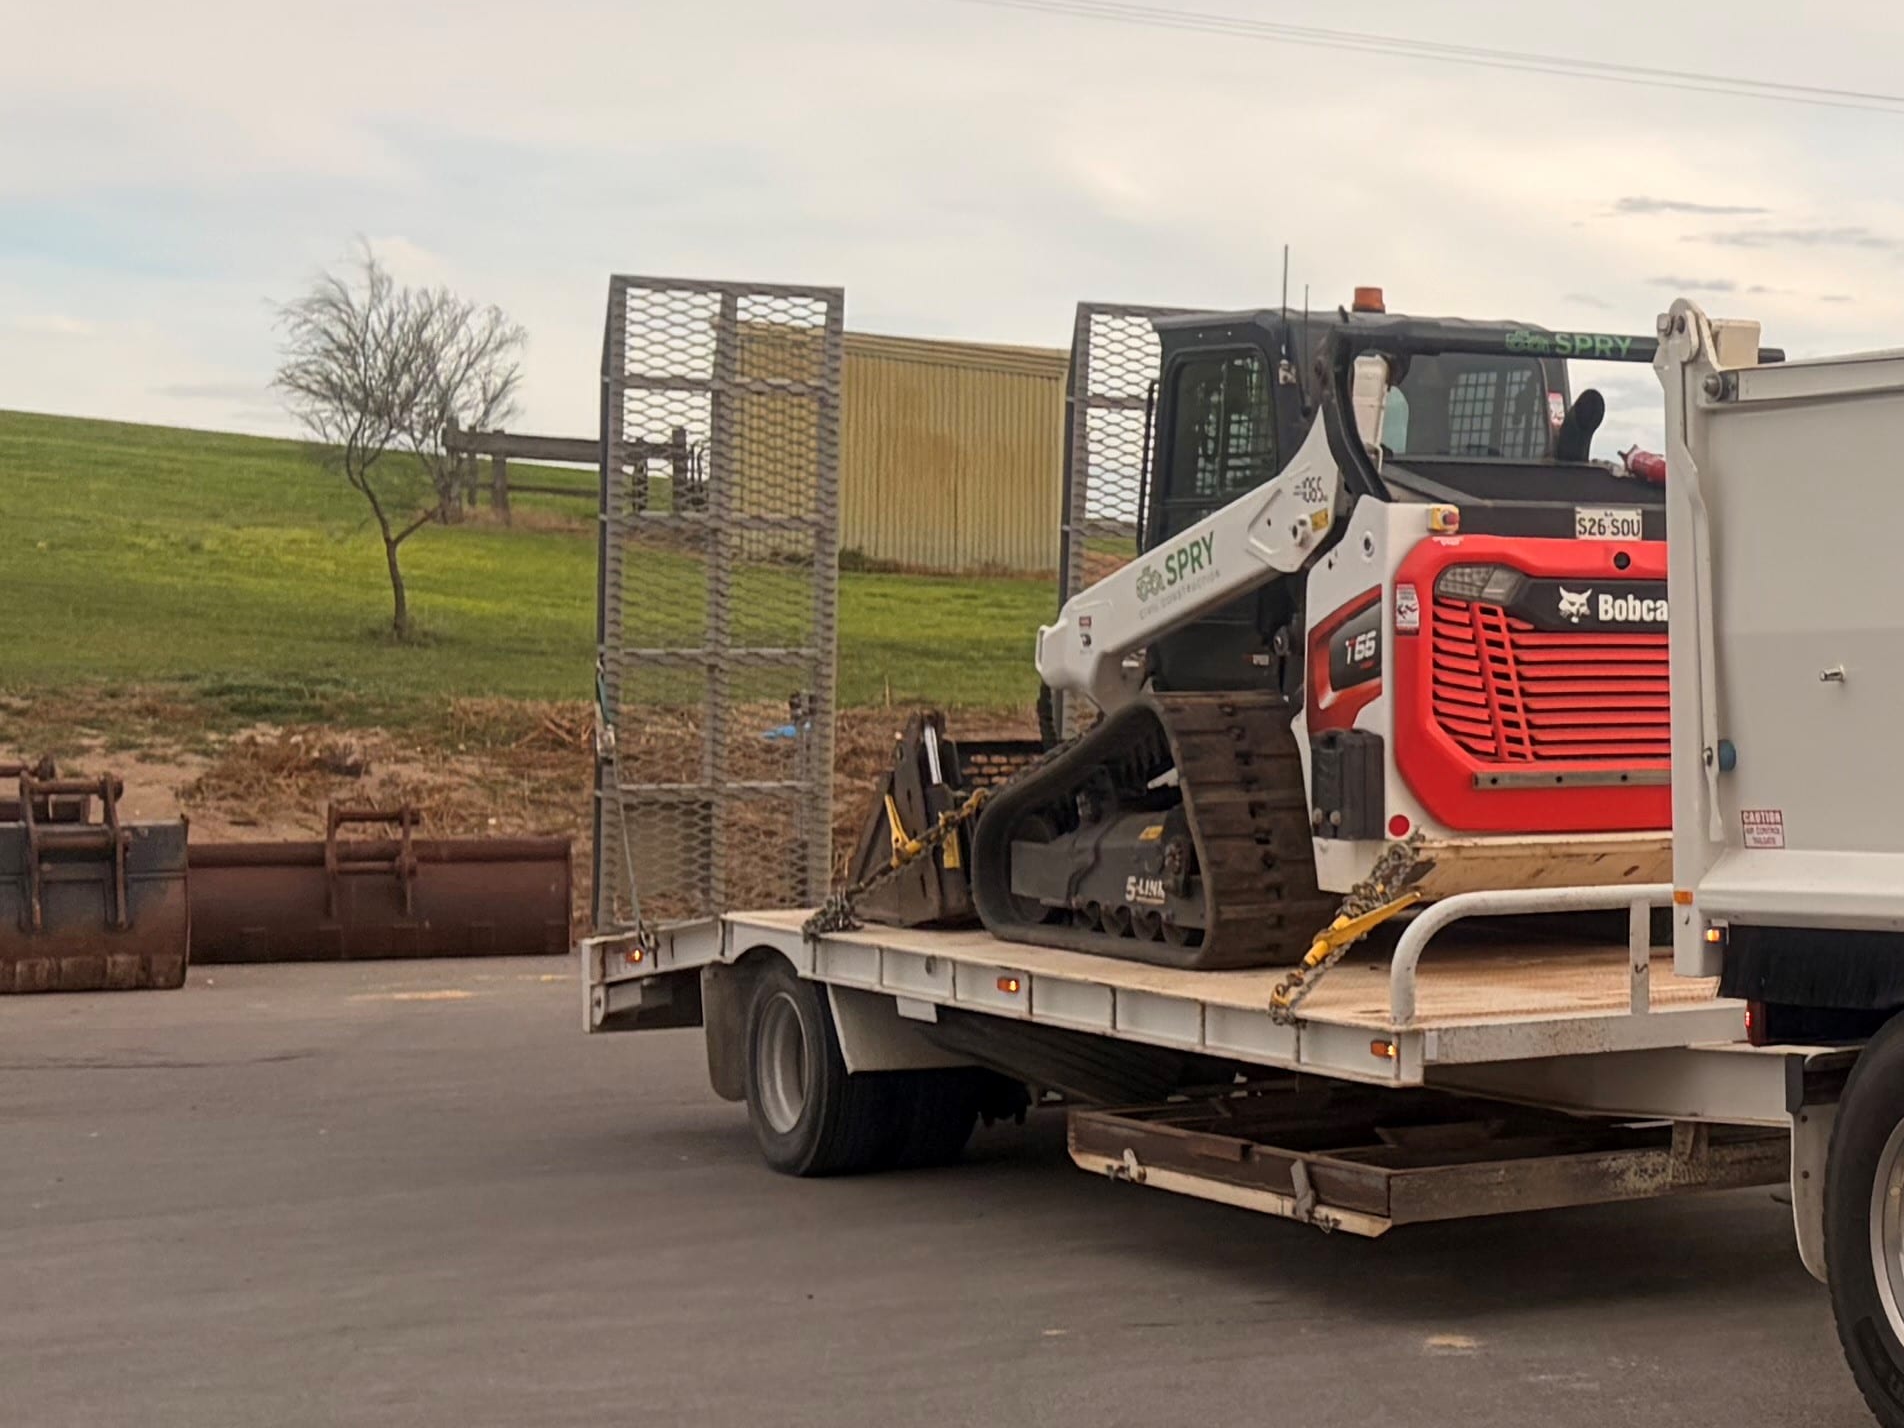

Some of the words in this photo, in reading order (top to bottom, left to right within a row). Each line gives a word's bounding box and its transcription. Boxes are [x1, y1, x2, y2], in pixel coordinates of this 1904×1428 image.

[1555, 334, 1632, 357] SPRY
[1164, 531, 1214, 586] SPRY
[1598, 593, 1668, 622] Bobca
[1345, 630, 1377, 665] T66
